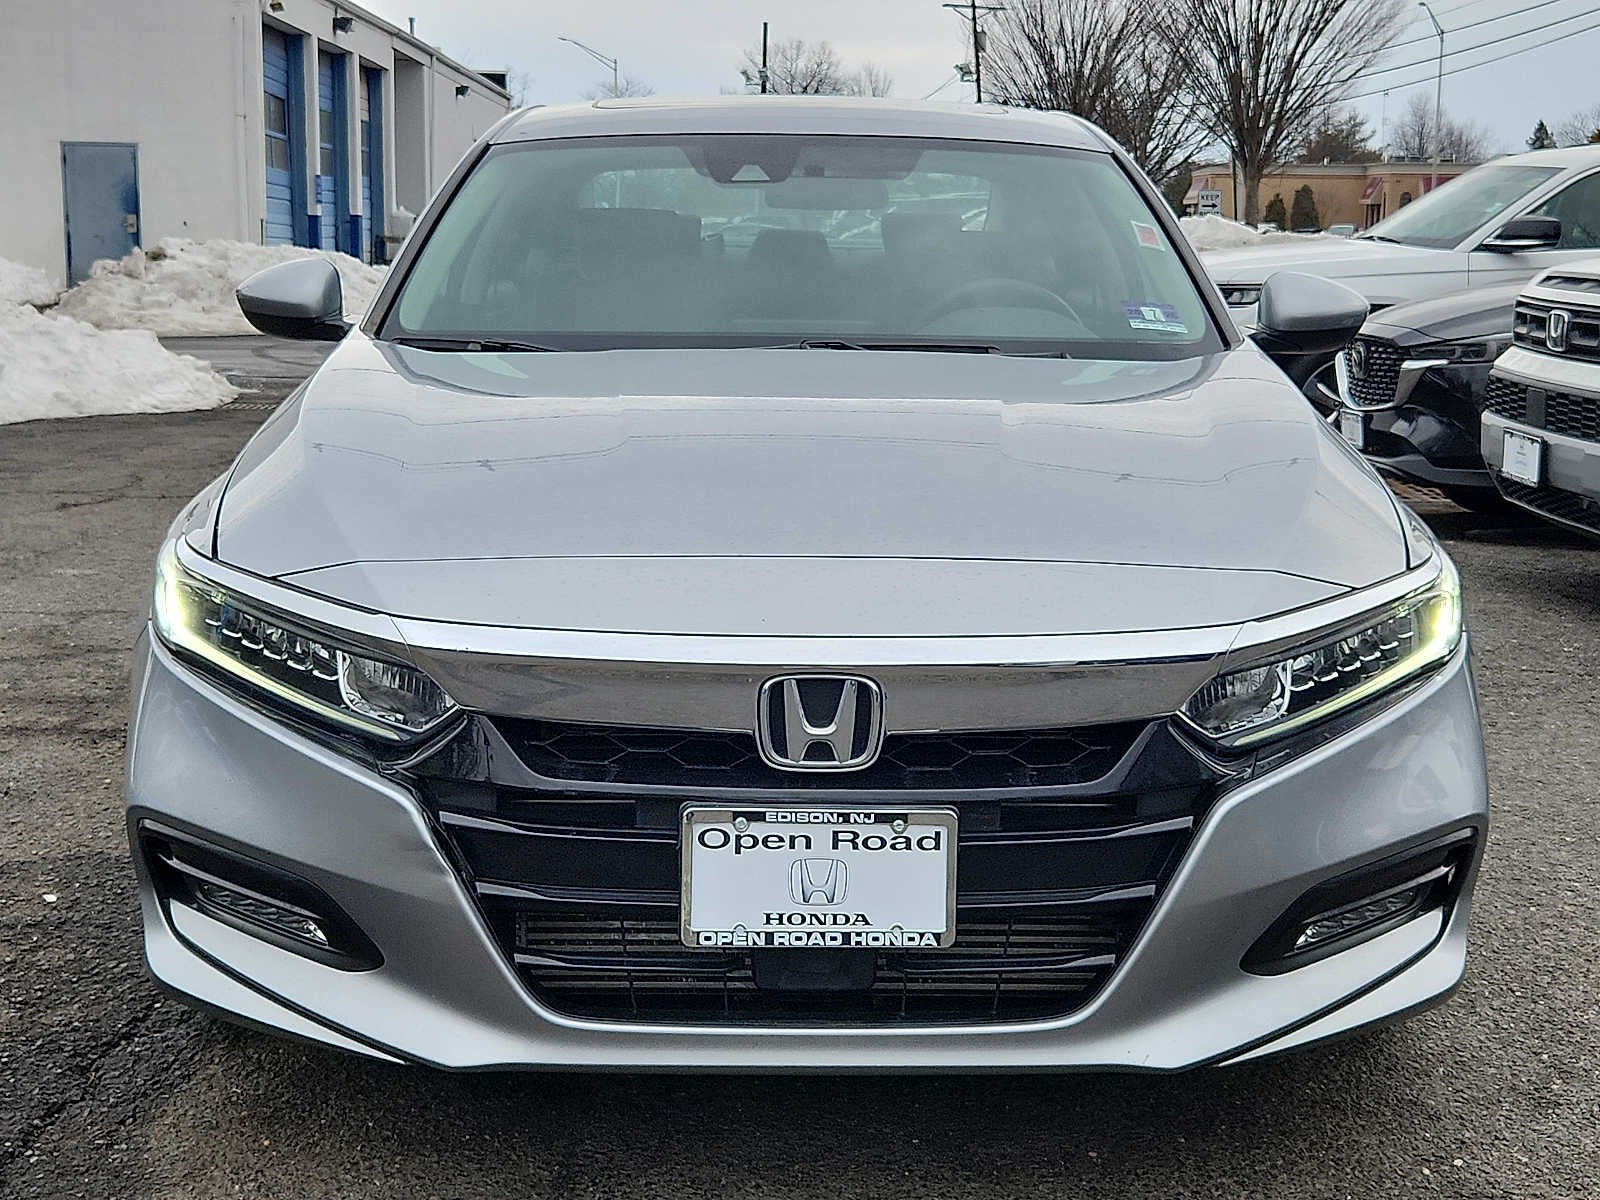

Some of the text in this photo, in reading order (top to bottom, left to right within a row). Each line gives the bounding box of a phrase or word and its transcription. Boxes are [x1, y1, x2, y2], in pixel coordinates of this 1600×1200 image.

[765, 811, 875, 824] EDISON, NJ
[697, 827, 941, 854] Open Road
[762, 912, 872, 926] HONDA
[699, 931, 938, 946] OPEN ROAD HONDA
